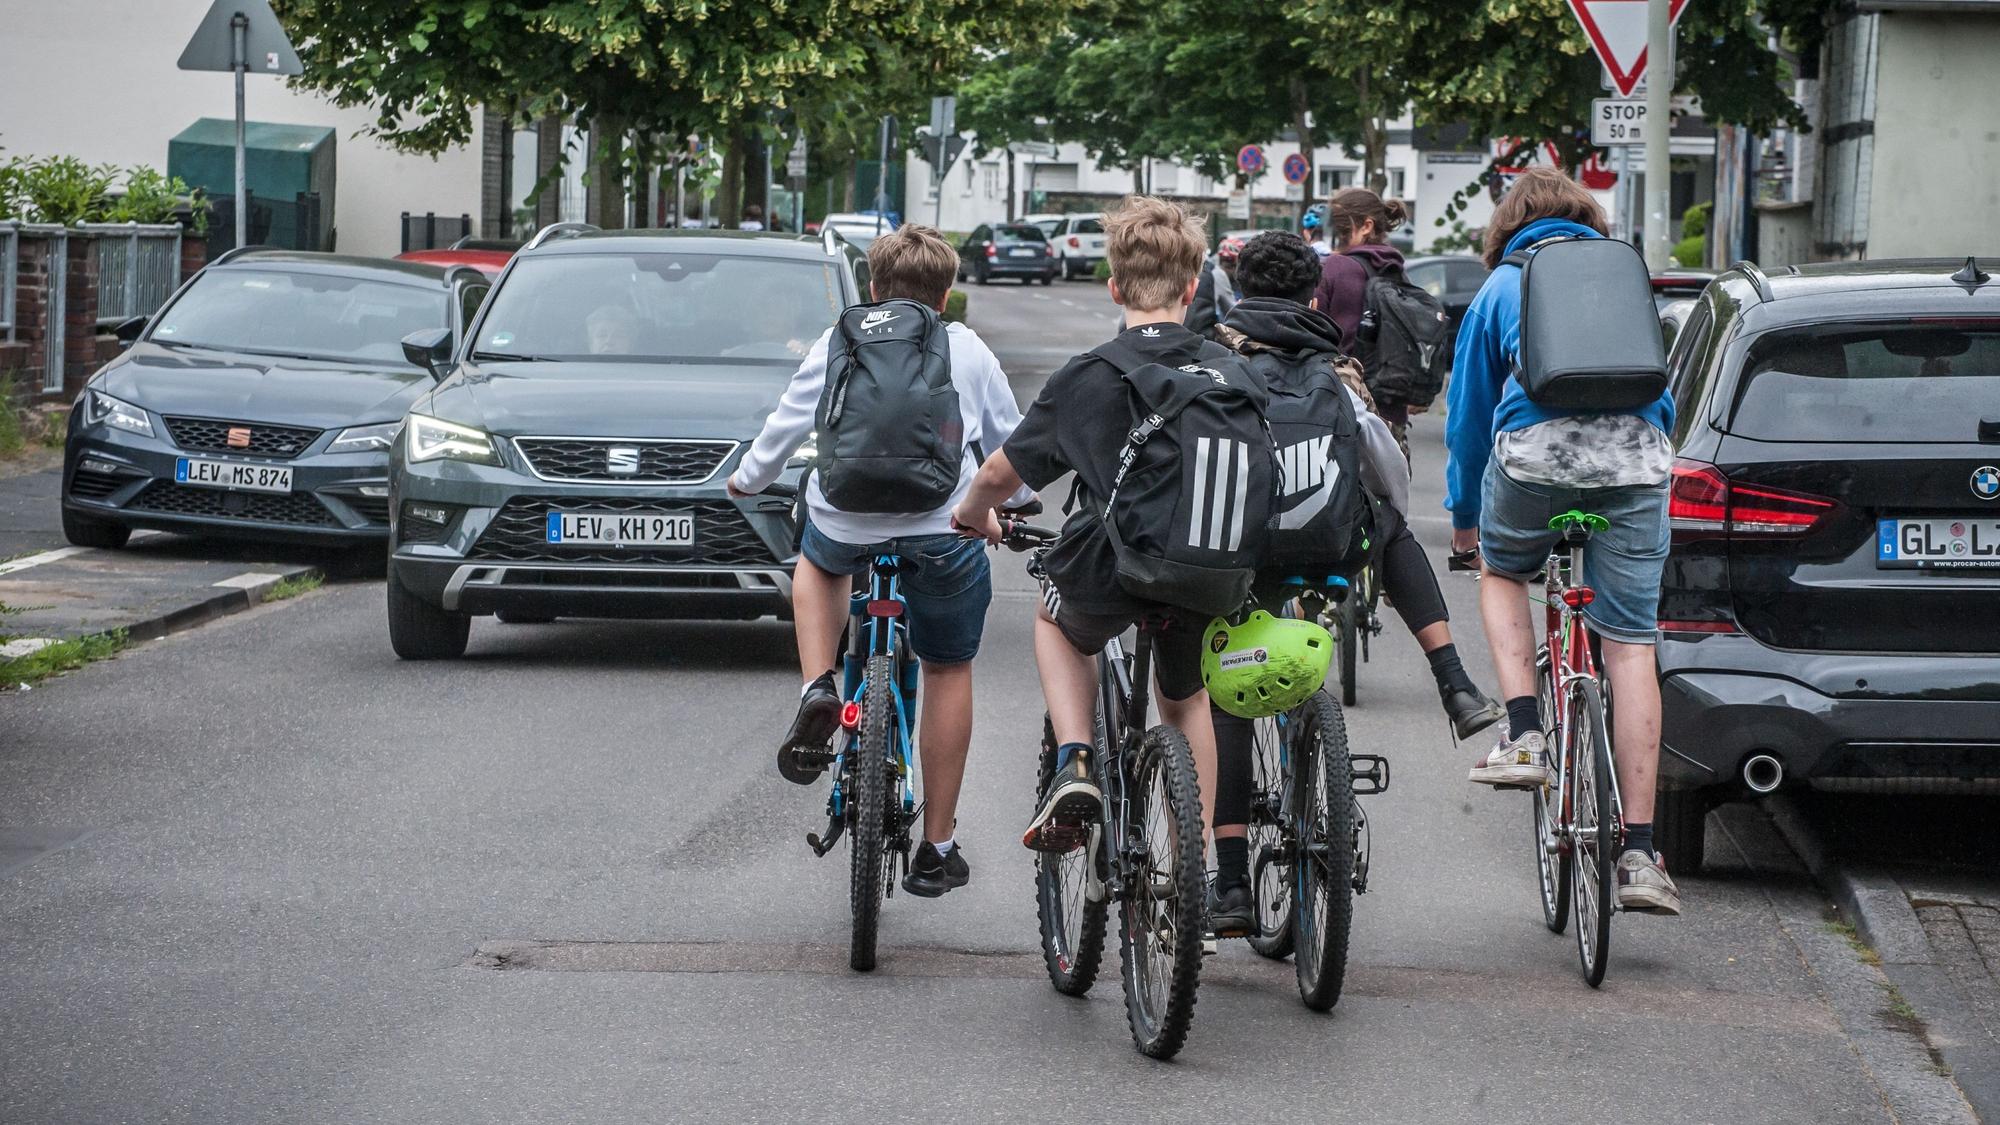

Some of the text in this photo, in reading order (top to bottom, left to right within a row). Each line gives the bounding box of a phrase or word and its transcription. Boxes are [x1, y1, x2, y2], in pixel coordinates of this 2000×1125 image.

[1603, 106, 1647, 119] STOP
[1610, 124, 1640, 138] 50 m
[866, 311, 892, 321] NIKE
[188, 462, 289, 488] LEV MS 874
[1275, 434, 1333, 496] NIK
[562, 517, 691, 541] LEV KH 910
[1901, 523, 2000, 556] GL L
